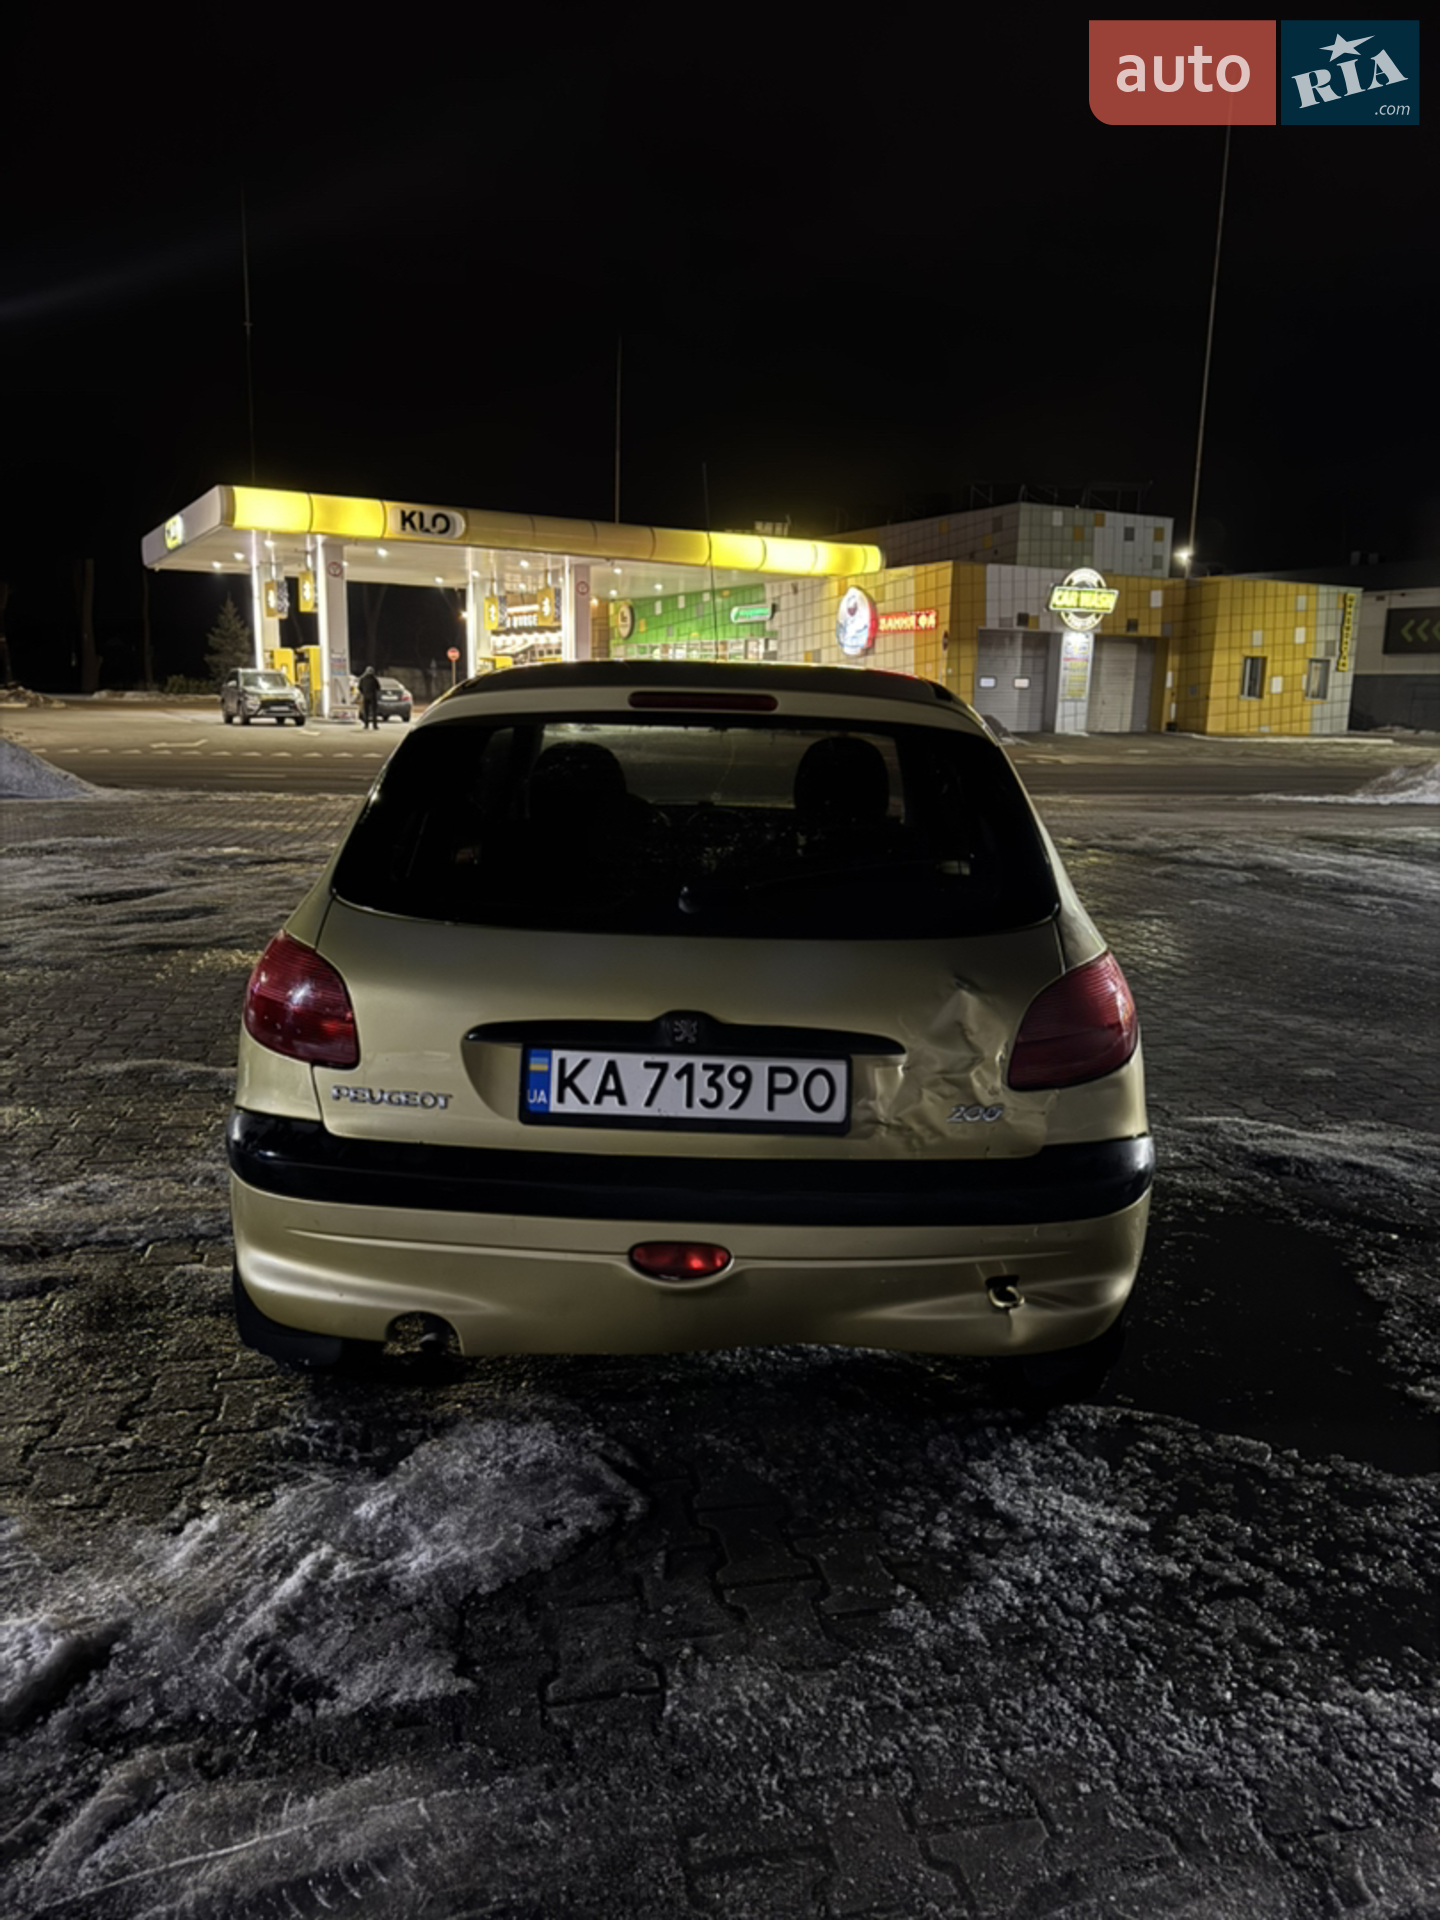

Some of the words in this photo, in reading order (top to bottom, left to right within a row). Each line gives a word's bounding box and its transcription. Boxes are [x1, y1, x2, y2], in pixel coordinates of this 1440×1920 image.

[400, 509, 451, 534] KLO
[331, 1085, 453, 1110] PEUGEOT
[527, 1088, 548, 1105] UA
[556, 1057, 628, 1106] KA
[642, 1061, 753, 1110] 7139
[767, 1066, 837, 1114] PO
